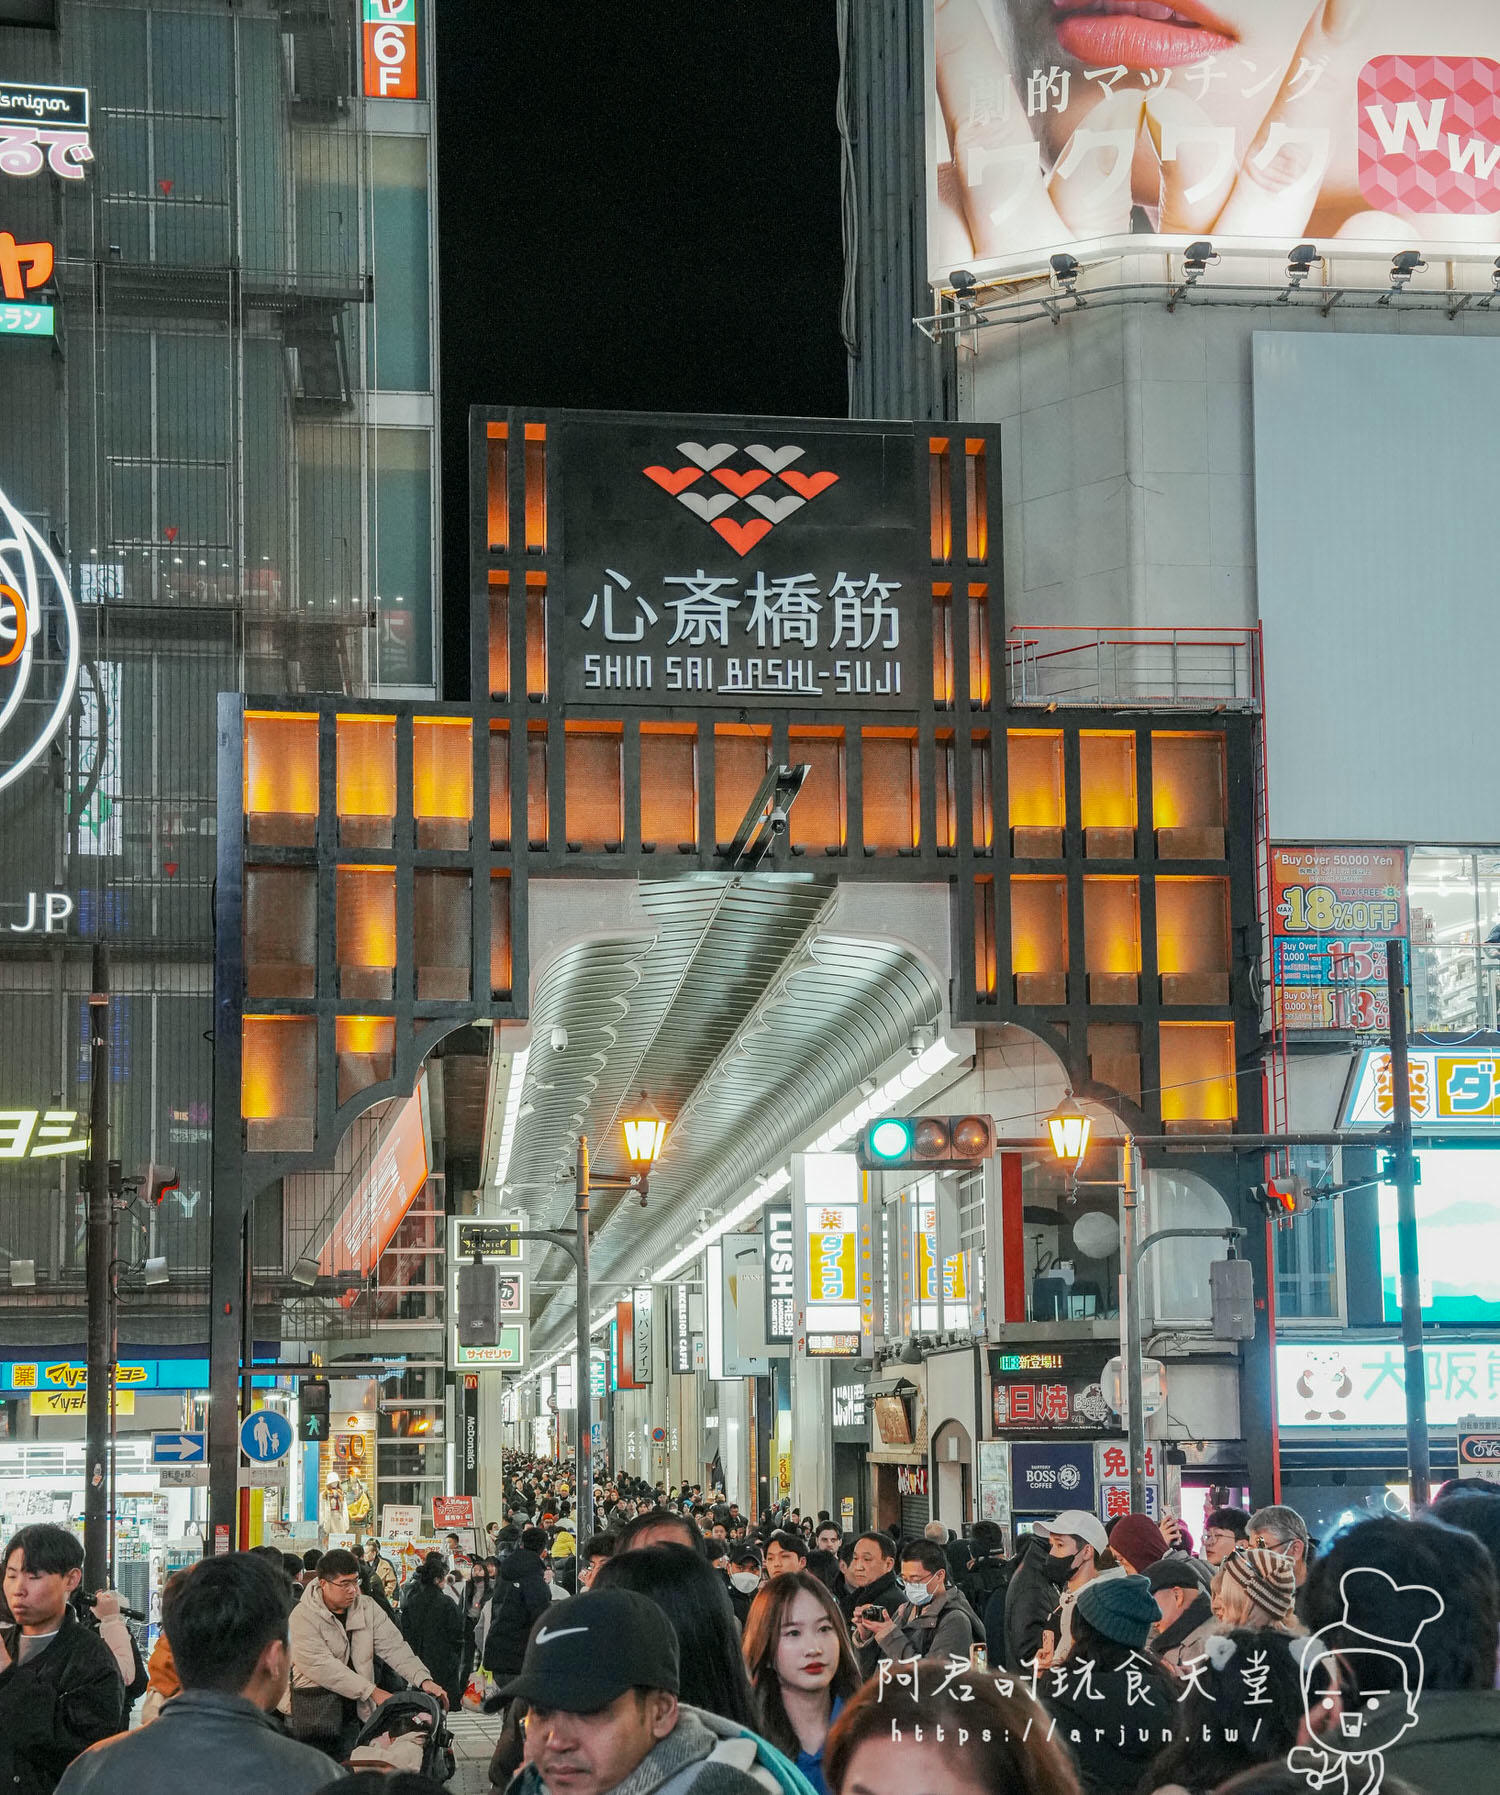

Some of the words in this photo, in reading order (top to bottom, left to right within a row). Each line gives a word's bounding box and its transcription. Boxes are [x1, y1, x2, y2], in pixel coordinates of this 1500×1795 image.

[0, 306, 42, 331] ラン
[580, 568, 902, 650] 心斎橋筋
[584, 654, 652, 690] SHIN
[666, 656, 713, 690] SAI
[1281, 854, 1302, 866] Buy
[1304, 854, 1331, 865] Over
[1333, 855, 1370, 866] 50,000
[1373, 855, 1393, 866] Yen
[10, 891, 74, 934] JP
[1276, 905, 1293, 914] MAX
[1279, 952, 1305, 962] 0,000
[1298, 941, 1318, 950] Over
[1284, 1002, 1306, 1012] 0,000
[1446, 1061, 1500, 1113] ダ
[820, 1207, 843, 1230] 薬
[769, 1212, 794, 1296] LUSH
[821, 1234, 844, 1299] ダイコク
[783, 1299, 794, 1336] FRESH
[466, 1349, 512, 1360] サイゼリヤ
[14, 1366, 36, 1386] 薬
[1009, 1384, 1069, 1420] 日焼
[467, 1415, 476, 1471] McDonald's
[1026, 1470, 1057, 1483] BOSS
